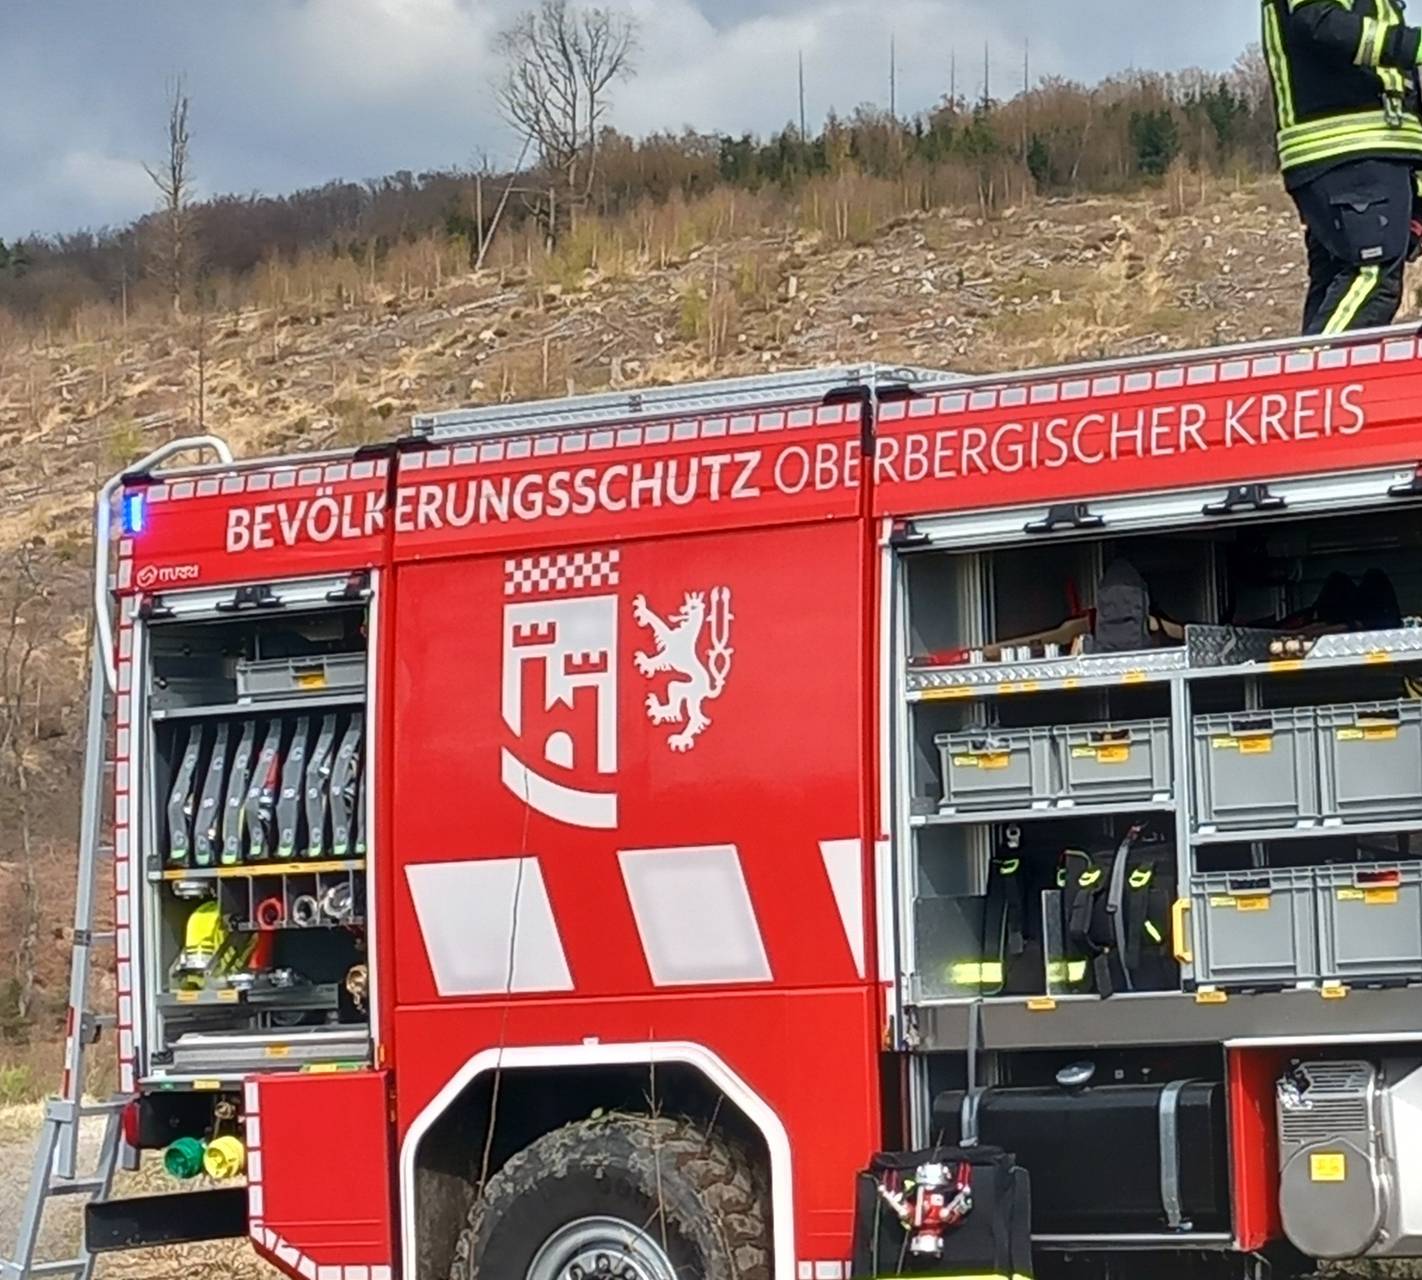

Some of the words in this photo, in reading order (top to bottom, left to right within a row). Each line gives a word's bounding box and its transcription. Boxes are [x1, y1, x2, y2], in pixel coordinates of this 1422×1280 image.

[226, 450, 761, 553] BEVÖLKERUNGSSCHUTZ
[774, 402, 1206, 495] OBERBERGISCHER
[1225, 384, 1364, 447] KREIS
